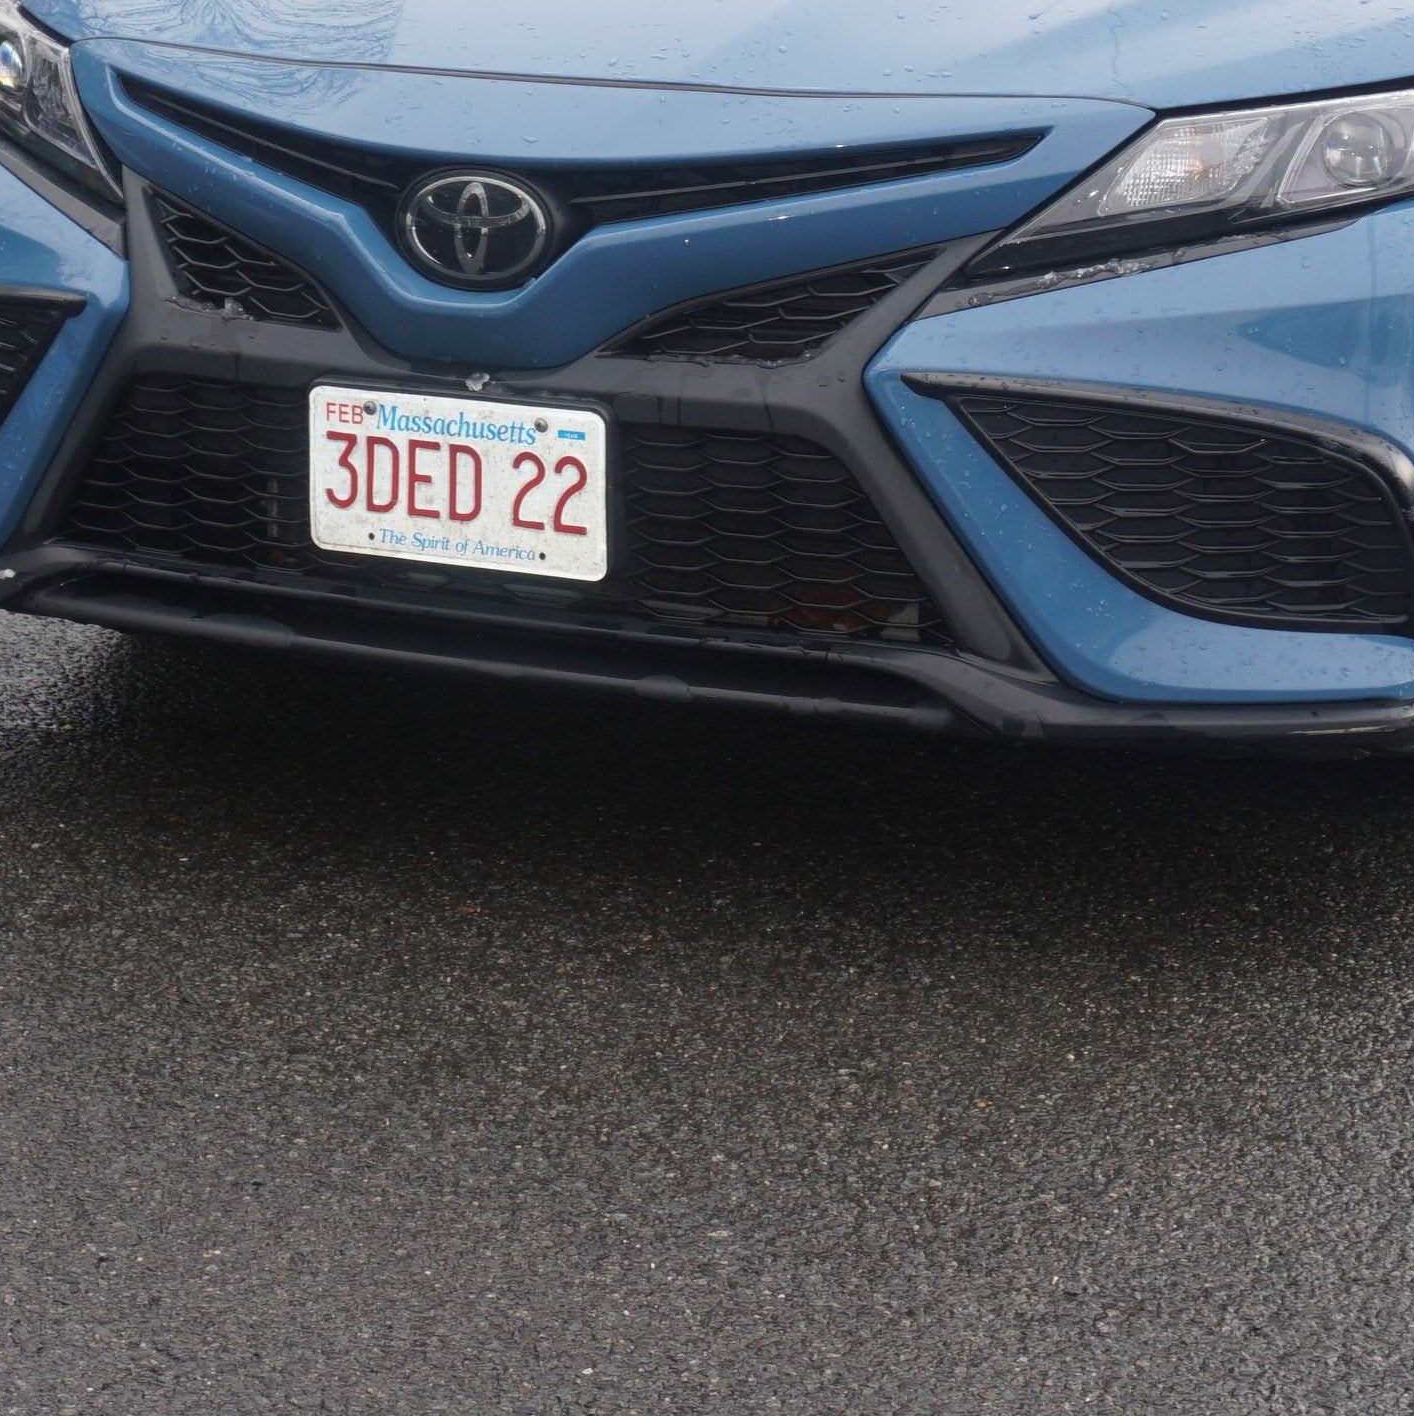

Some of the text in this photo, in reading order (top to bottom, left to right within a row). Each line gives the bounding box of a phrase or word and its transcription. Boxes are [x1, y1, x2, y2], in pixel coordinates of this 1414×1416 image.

[325, 401, 364, 424] FEB
[376, 403, 537, 446] Massachusetts
[325, 430, 588, 534] 3DED 22
[379, 528, 537, 561] The Spirit of America
